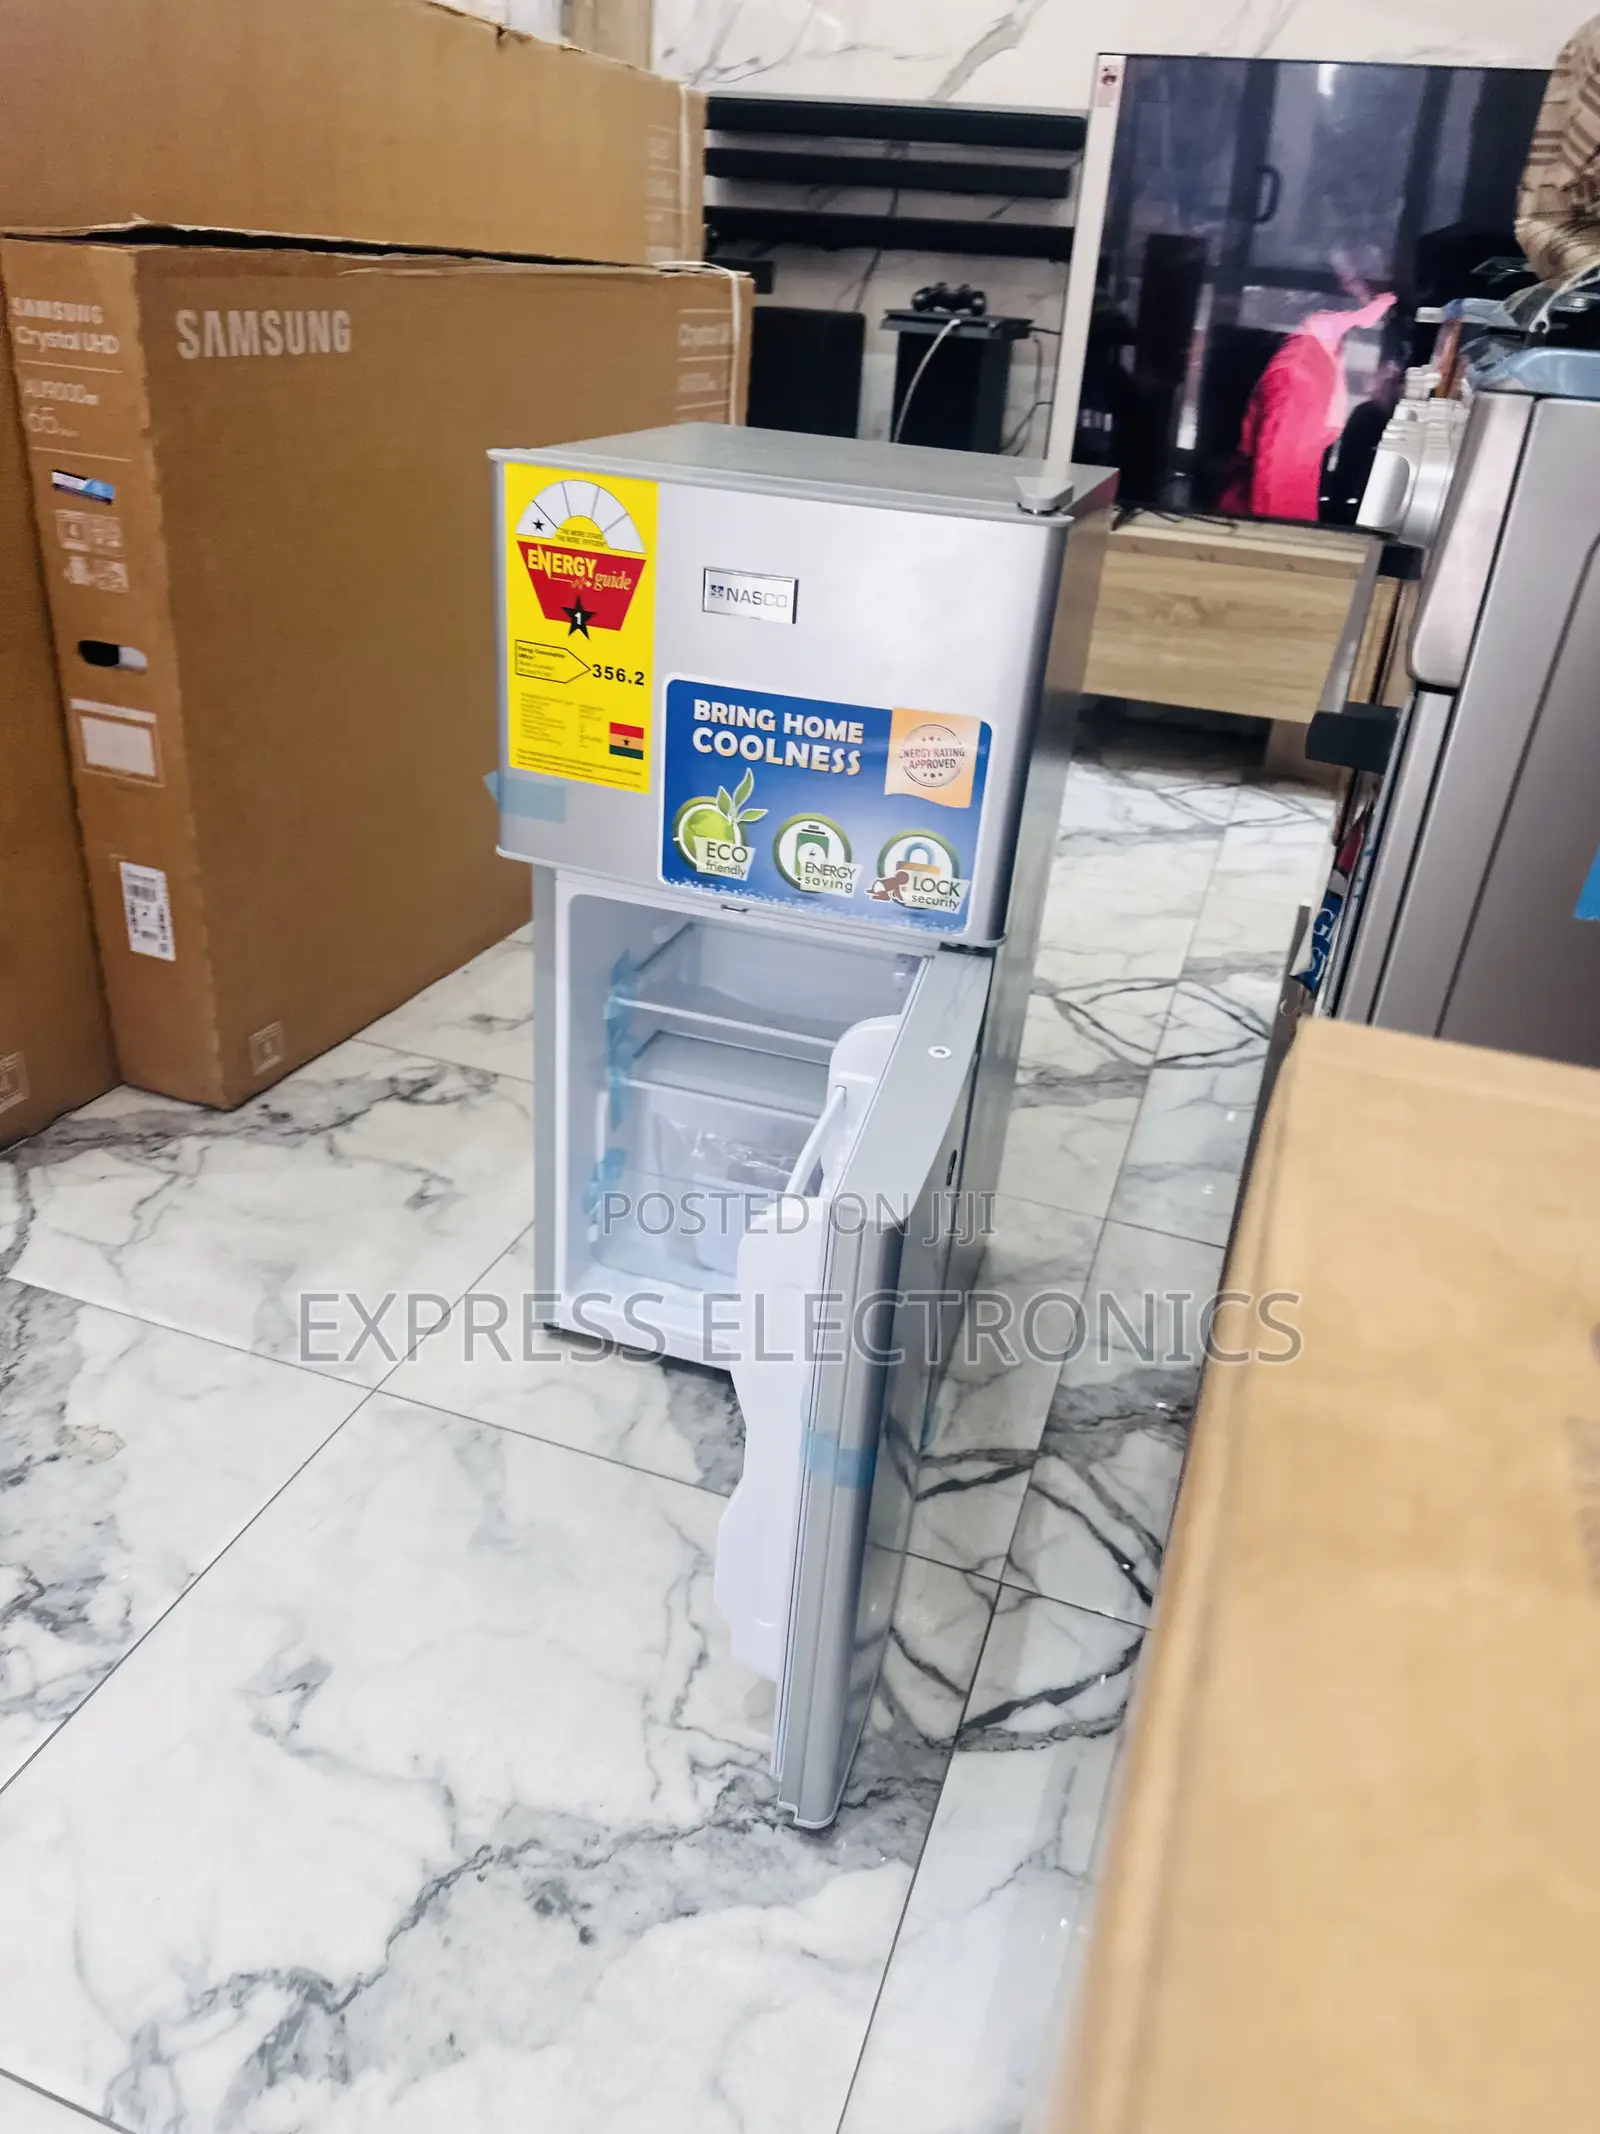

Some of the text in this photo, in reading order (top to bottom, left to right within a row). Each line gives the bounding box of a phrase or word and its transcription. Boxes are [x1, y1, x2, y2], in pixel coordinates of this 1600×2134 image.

[11, 297, 104, 325] SAMSUNG
[175, 309, 352, 359] SAMSUNG
[527, 544, 597, 579] ENERGY
[593, 570, 632, 591] guide
[726, 587, 787, 608] NASCO
[574, 612, 582, 625] 1
[591, 664, 645, 686] 356.2
[693, 698, 864, 745] BRING HOME
[692, 727, 862, 777] COOLNESS
[933, 747, 965, 758] RATING
[909, 758, 957, 770] APPROVED
[706, 841, 748, 864] ECO
[705, 859, 746, 878] friendly
[805, 861, 857, 880] ENERGY
[804, 875, 853, 894] saving
[912, 876, 961, 898] LOCK
[911, 893, 960, 912] security
